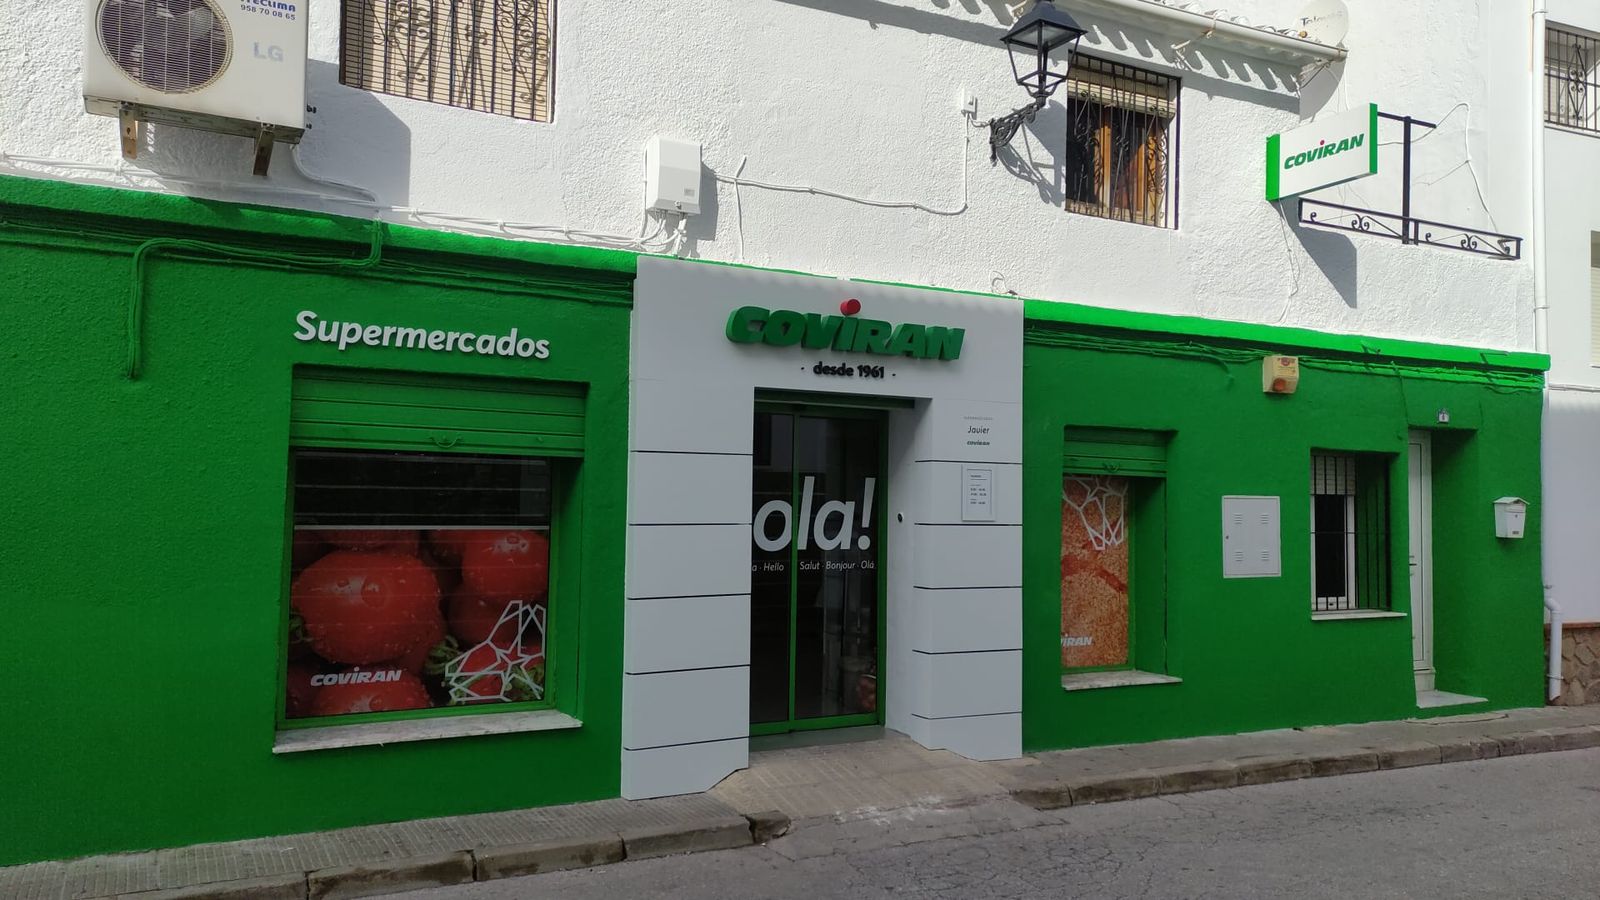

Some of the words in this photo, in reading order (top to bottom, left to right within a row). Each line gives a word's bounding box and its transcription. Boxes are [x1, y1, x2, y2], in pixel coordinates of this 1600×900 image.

[253, 41, 284, 62] LG
[1284, 133, 1365, 170] COVIRAN
[293, 310, 550, 359] Supermercados
[726, 298, 966, 361] COVIRAN
[813, 361, 854, 377] desde
[857, 364, 885, 379] 1961
[753, 475, 876, 552] ola!
[763, 562, 784, 572] Hello
[799, 560, 820, 570] Salut
[825, 560, 856, 571] Bonjour
[310, 666, 402, 686] COVIRAN
